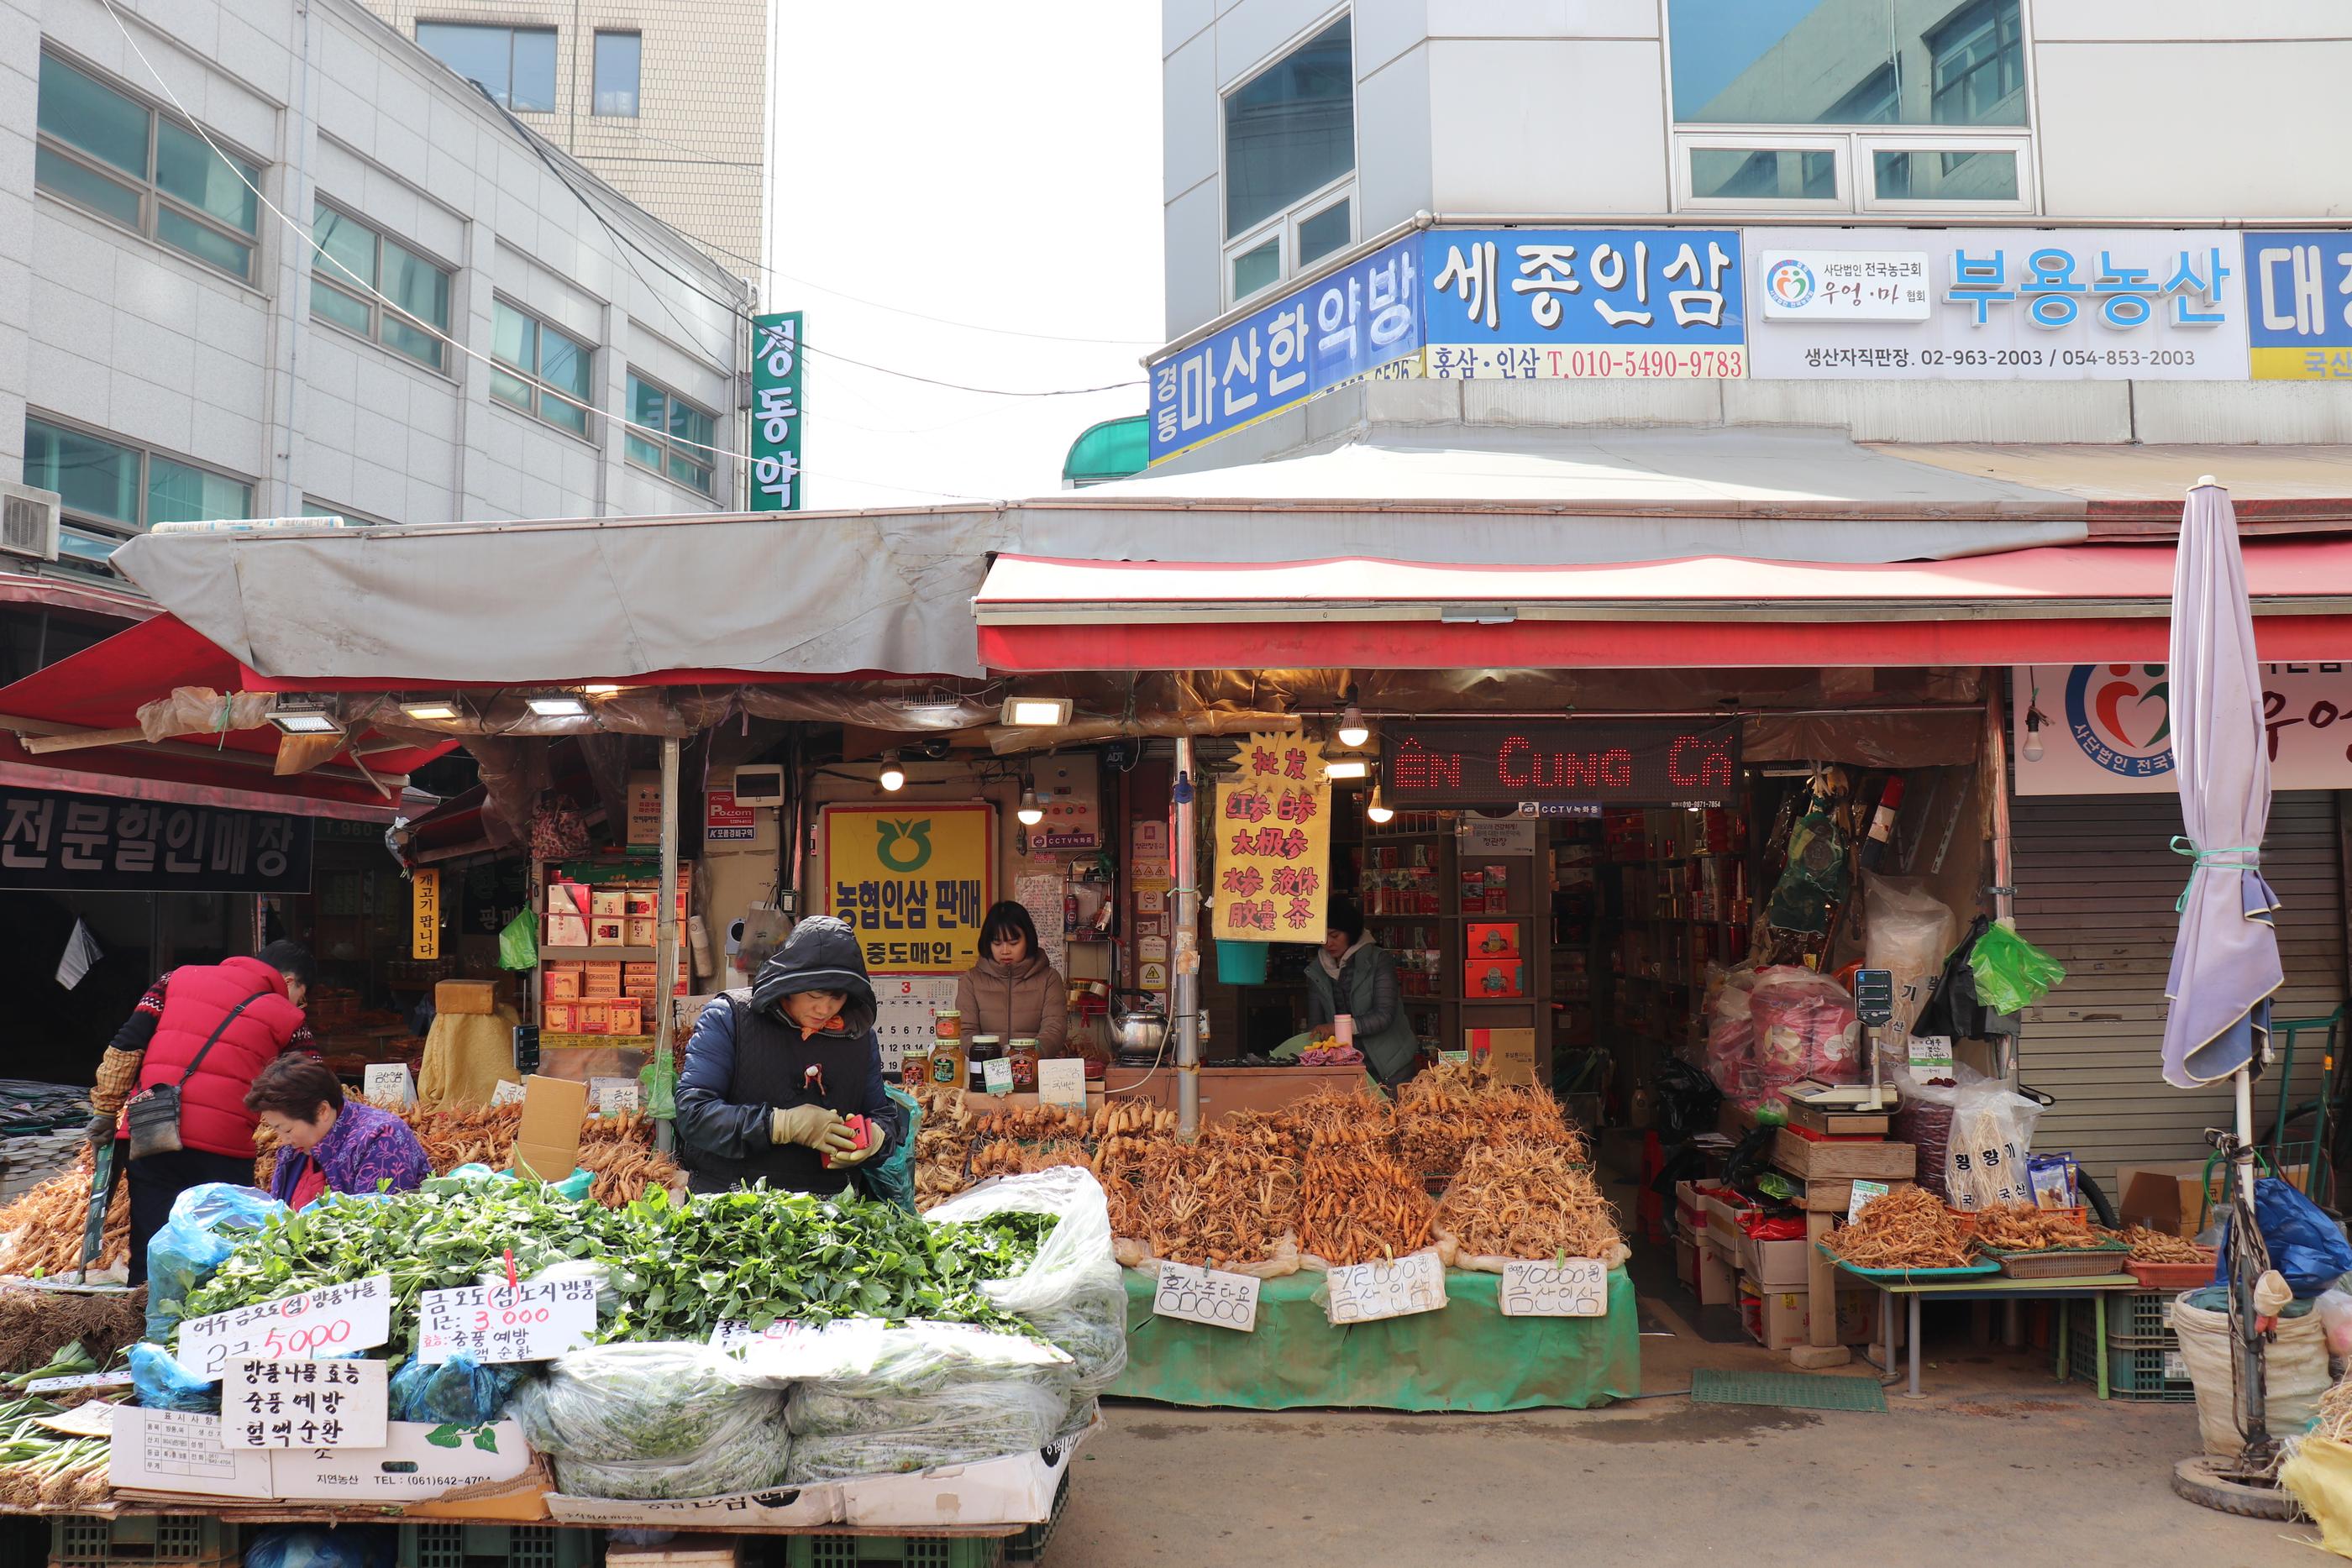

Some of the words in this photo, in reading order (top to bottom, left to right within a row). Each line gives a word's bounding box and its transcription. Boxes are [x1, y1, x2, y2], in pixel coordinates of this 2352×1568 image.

[1824, 263, 1862, 277] 사단법인
[1864, 262, 1922, 277] 전국농근회
[1434, 241, 1732, 328] 세종인삼
[1905, 289, 1926, 303] 협회
[1942, 247, 2230, 329] 부용농산
[1180, 251, 1416, 432] 마산한약방
[1920, 349, 2044, 366] 02-963-2003
[2061, 349, 2196, 366] 054-853-2003
[1157, 363, 1179, 443] 경동
[2074, 723, 2128, 773] 사단법인
[1251, 746, 1308, 780] 批发
[1225, 792, 1271, 823] 红参
[1277, 790, 1317, 825] 白参
[1231, 826, 1309, 860] 太极参
[419, 873, 434, 912] 개고기
[836, 879, 928, 930] 농협인삼
[936, 879, 981, 929] 판매
[1283, 898, 1315, 929] 茶
[419, 915, 434, 957] 팝니다
[866, 941, 952, 965] 중도매인
[901, 981, 911, 994] 3
[877, 1026, 883, 1035] 4
[890, 1026, 896, 1035] 5
[903, 1026, 910, 1035] 6
[916, 1026, 922, 1035] 7
[929, 1026, 935, 1035] 8
[889, 1044, 898, 1052] 12
[889, 1062, 898, 1070] 19
[1998, 1183, 2026, 1201] 국산
[194, 1314, 228, 1336] 여수
[235, 1303, 280, 1326] 금오도
[312, 1281, 377, 1309] 방풍나물
[450, 1330, 487, 1348] 중풍
[492, 1328, 529, 1345] 예방
[496, 1345, 533, 1361] 순환
[244, 1360, 318, 1385] 방풍나물
[323, 1363, 360, 1385] 효능
[291, 1390, 346, 1415] 예방
[297, 1418, 344, 1445] 순환
[316, 1474, 359, 1485] 지연농산
[374, 1475, 396, 1486] TEL
